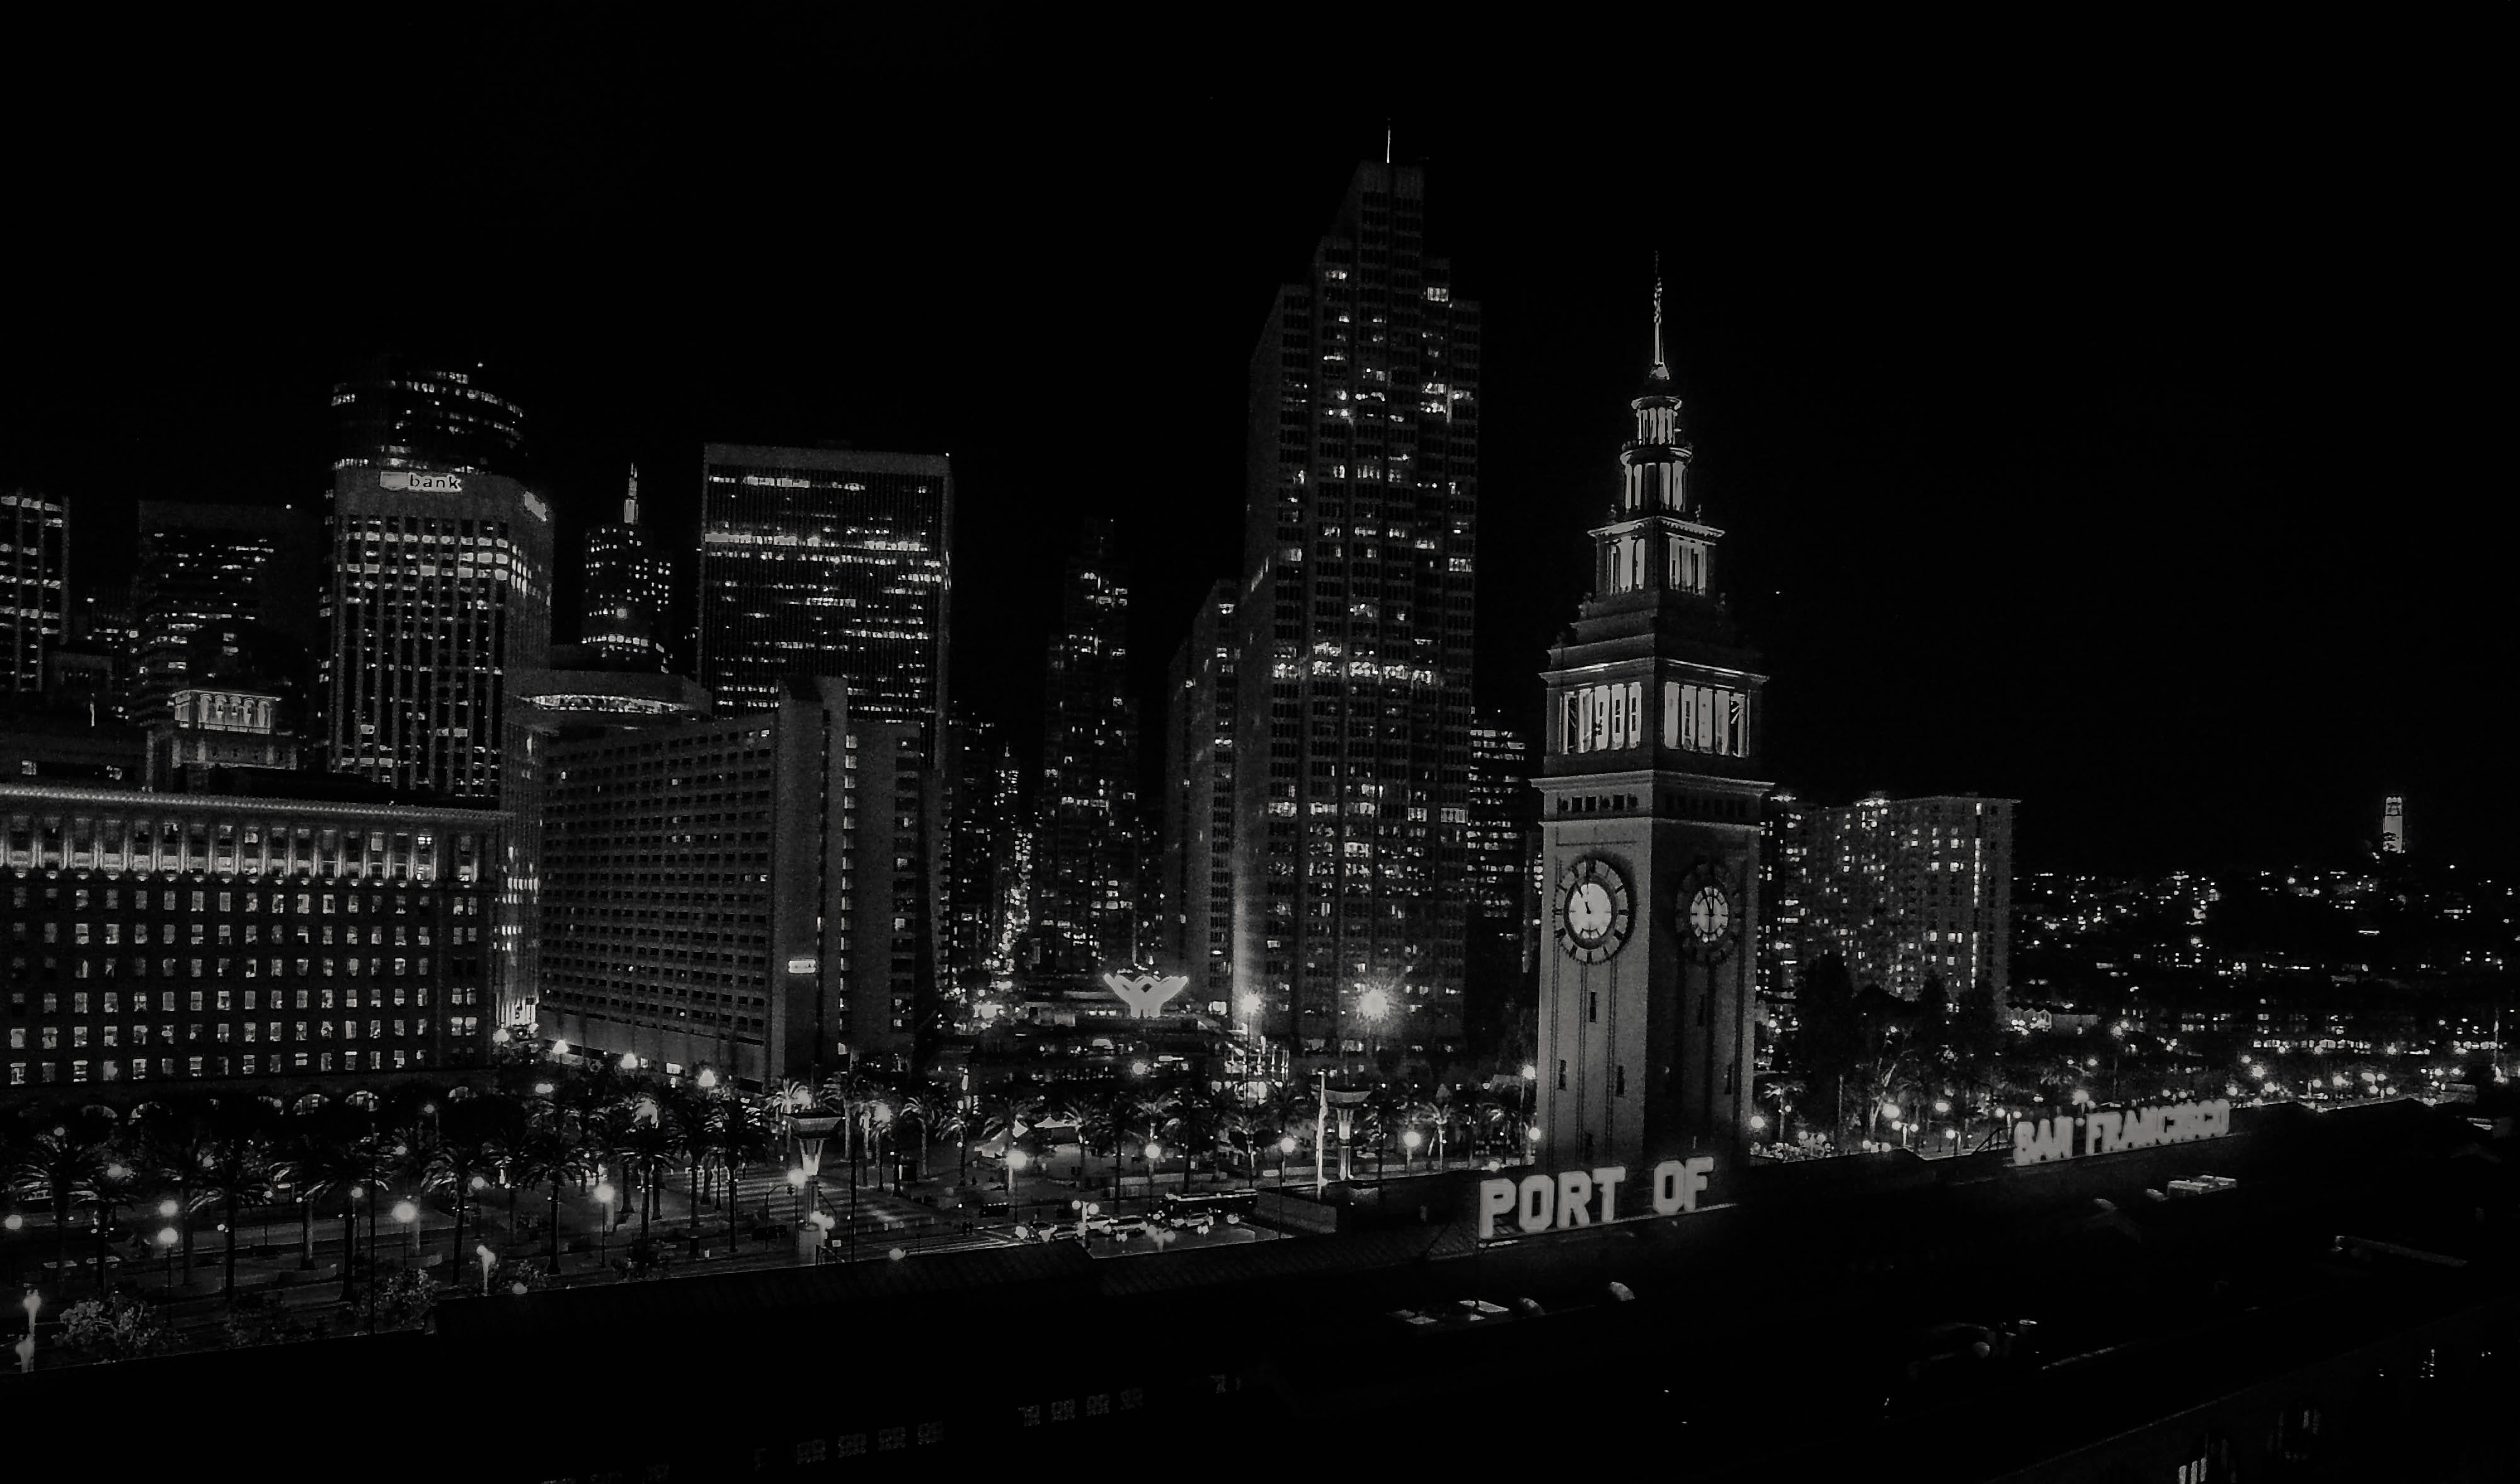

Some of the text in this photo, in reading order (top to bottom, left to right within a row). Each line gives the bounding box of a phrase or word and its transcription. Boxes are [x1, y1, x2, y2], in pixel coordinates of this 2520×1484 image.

[410, 473, 458, 489] bank
[2013, 1099, 2229, 1165] SAN FRANCISCO
[1479, 1157, 1713, 1238] PORT OF
